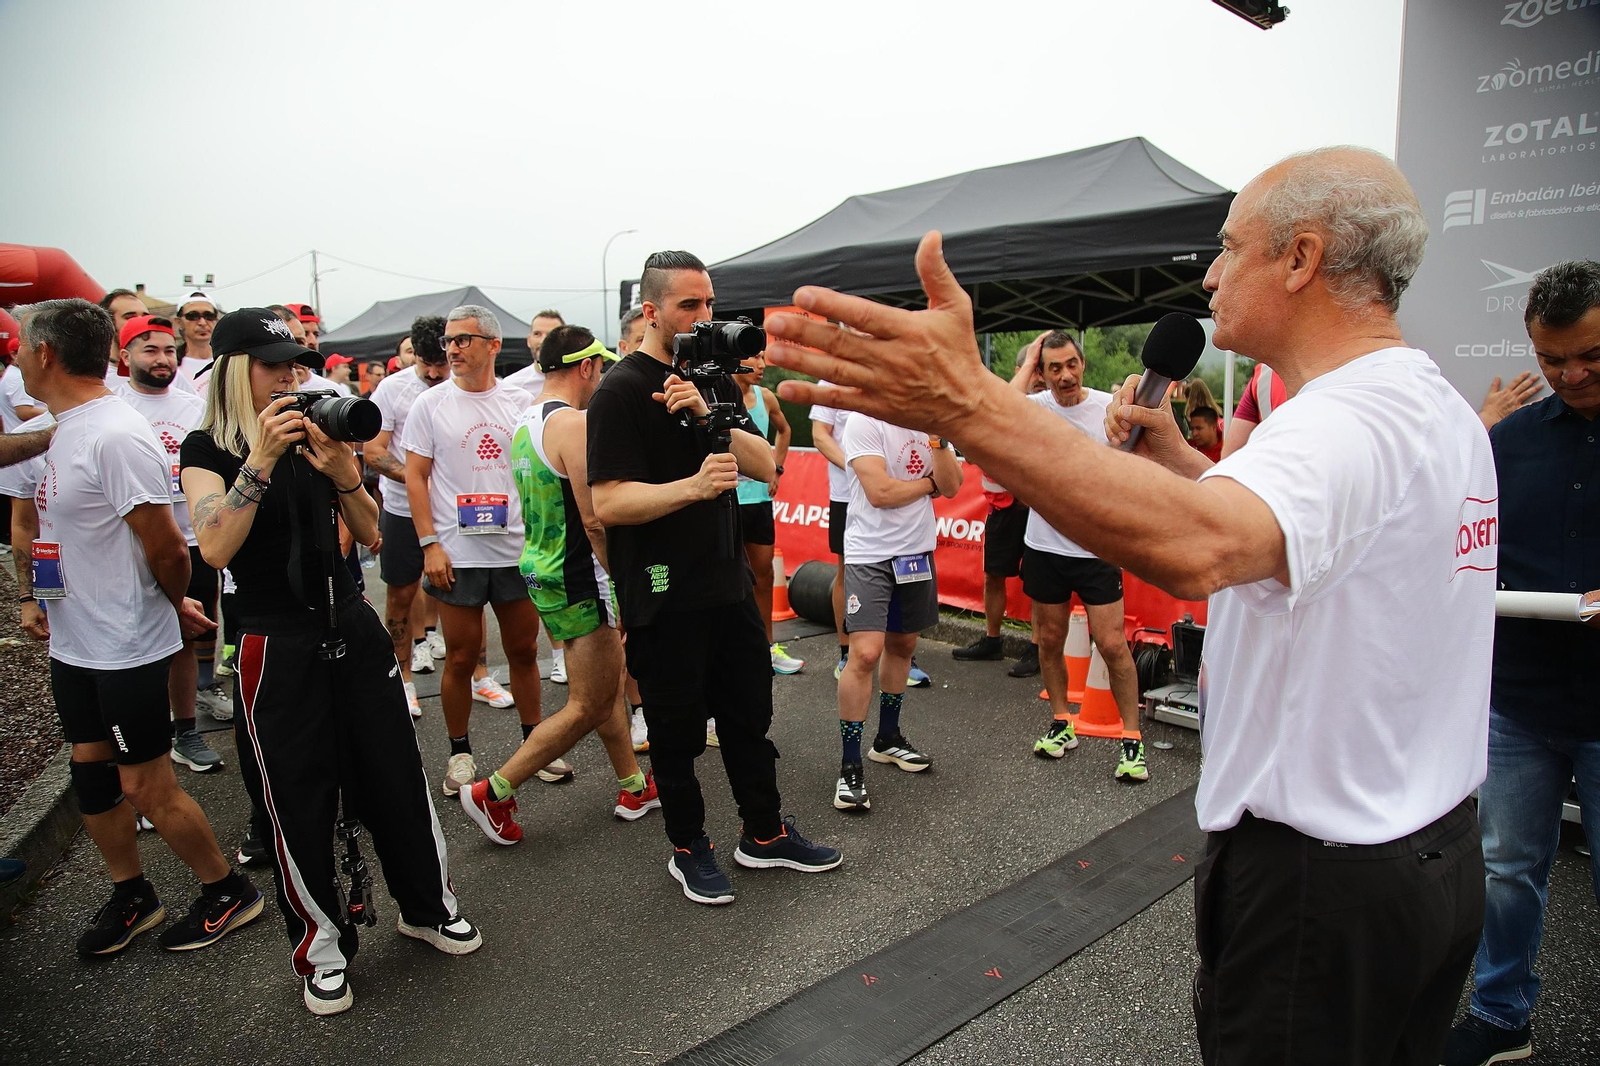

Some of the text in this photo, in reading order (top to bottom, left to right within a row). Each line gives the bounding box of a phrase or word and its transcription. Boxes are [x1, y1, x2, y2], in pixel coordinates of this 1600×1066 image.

[1483, 113, 1598, 148] ZOTAL
[1482, 142, 1596, 163] LABORATORIOS
[1490, 186, 1565, 205] Embalán
[1490, 210, 1516, 220] diseño
[1525, 206, 1572, 218] fabricación
[1573, 204, 1585, 213] de
[476, 512, 493, 523] 22
[936, 517, 986, 542] NOR
[946, 540, 970, 549] SPORTS
[650, 565, 669, 573] NEW
[909, 561, 918, 571] 11
[650, 571, 669, 580] NEW
[652, 585, 669, 593] NEW
